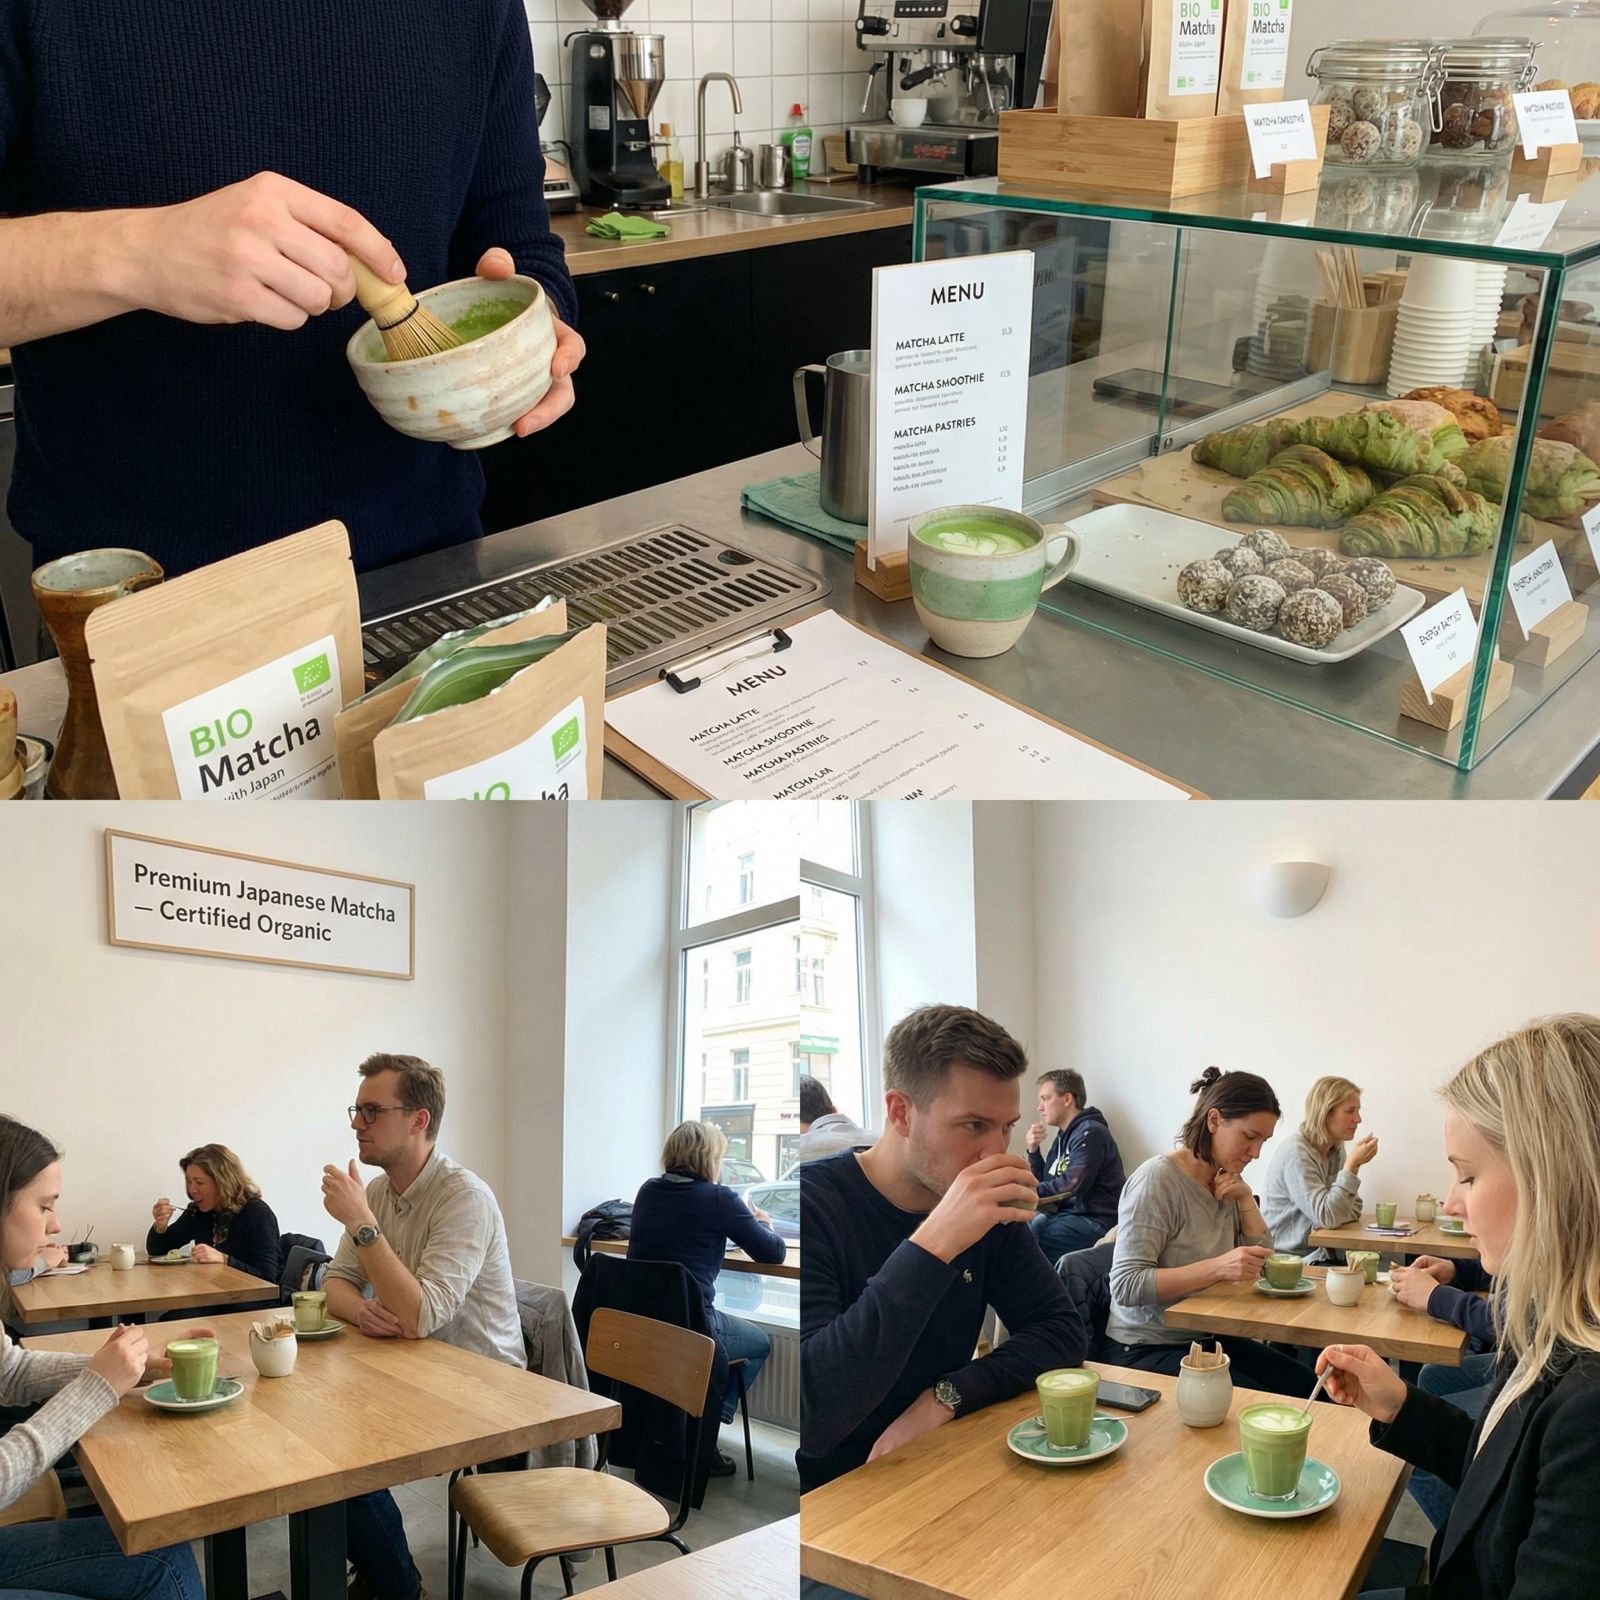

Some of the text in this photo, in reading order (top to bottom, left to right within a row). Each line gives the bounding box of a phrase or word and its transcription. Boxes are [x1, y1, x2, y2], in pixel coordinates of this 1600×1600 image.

[1180, 2, 1201, 18] BIO
[1253, 2, 1271, 17] BIO
[1179, 19, 1216, 36] Matcha
[1251, 18, 1285, 34] Matcha
[930, 281, 985, 306] MENU
[895, 332, 966, 351] MATCHA LATTE
[894, 381, 935, 396] MATCHA
[936, 372, 985, 389] SMOOTHIE
[893, 416, 976, 440] MATCHA PASTRIES
[726, 665, 787, 697] MENU
[189, 708, 254, 758] BIO
[688, 707, 760, 743] MATCHA LATTE
[722, 717, 815, 766] MATCHA SMOOTHIE
[198, 716, 322, 793] Matcha
[743, 755, 788, 780] MATCHA
[249, 768, 286, 794] Japan
[773, 776, 818, 800] MATCHA
[133, 862, 396, 922] Premium Japanese Matcha
[159, 900, 251, 931] Certified
[257, 914, 332, 942] Organic
